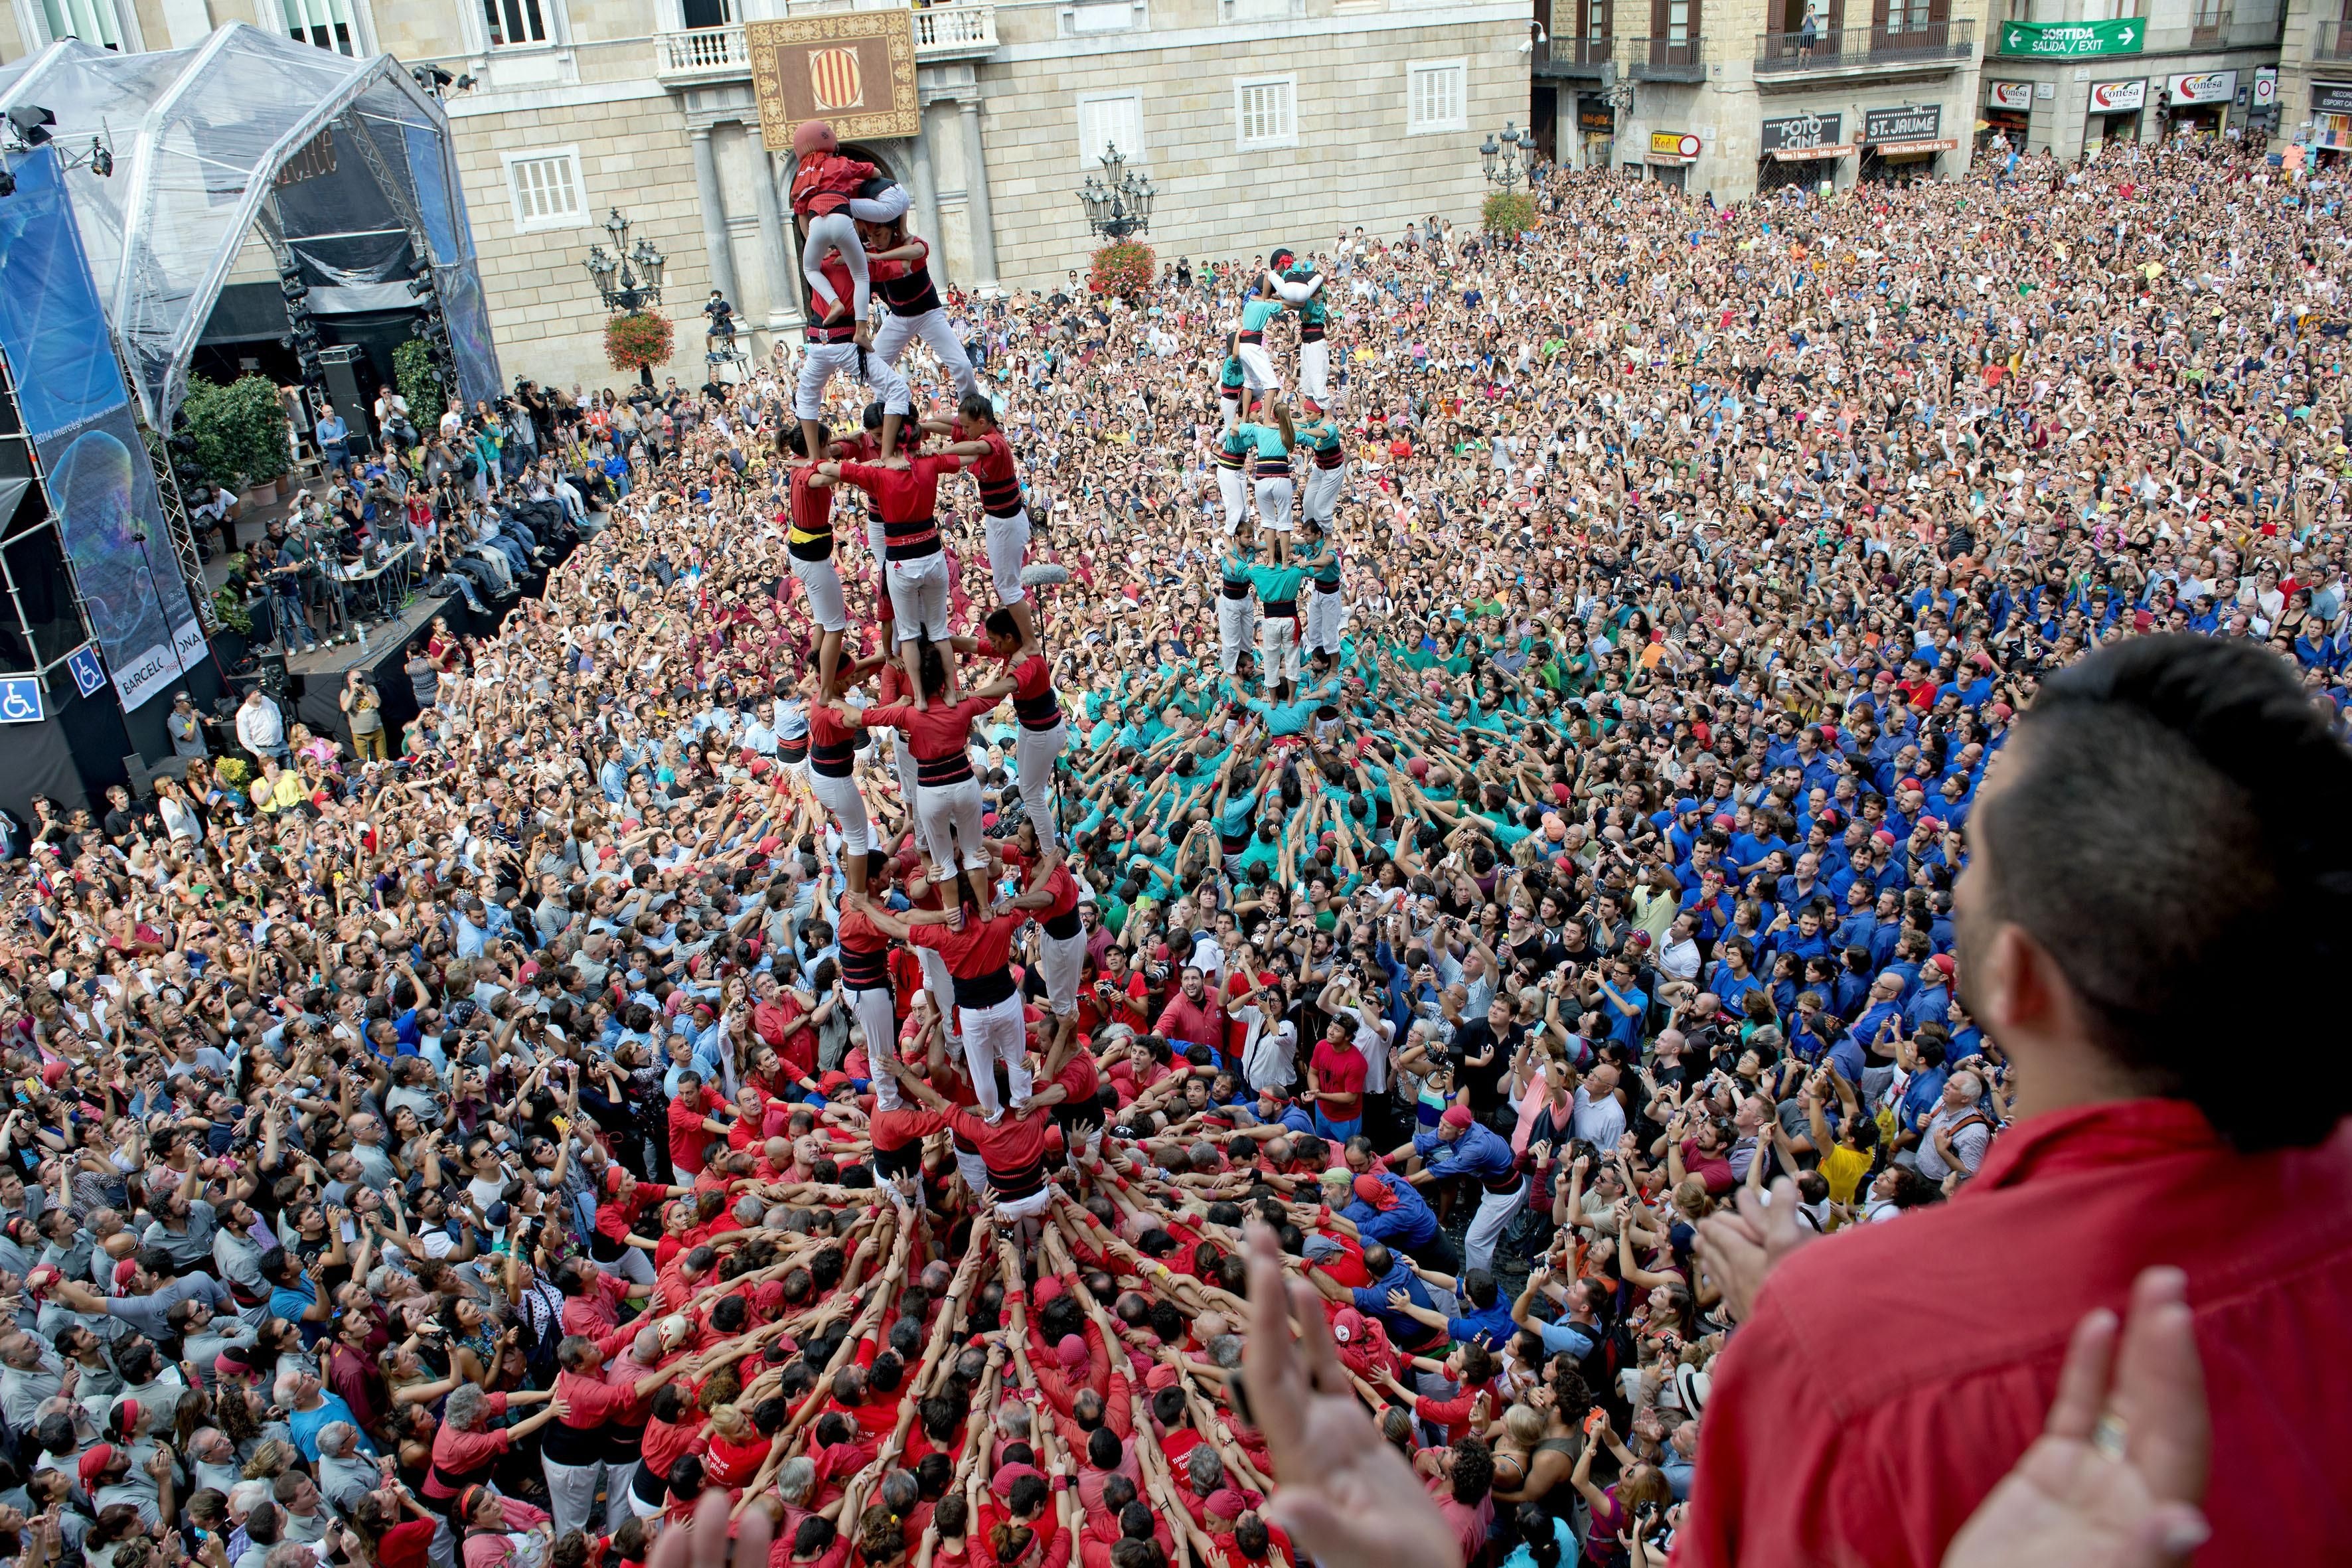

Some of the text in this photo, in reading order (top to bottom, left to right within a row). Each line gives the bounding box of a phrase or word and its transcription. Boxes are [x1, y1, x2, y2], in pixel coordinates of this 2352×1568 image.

[2041, 27, 2094, 40] SORTIDA
[2032, 39, 2104, 54] SALIDA / EXIT
[2189, 79, 2223, 90] conesa
[2002, 88, 2027, 97] conesa
[2103, 88, 2139, 99] conesa
[1781, 118, 1822, 137] FOTO
[1869, 116, 1935, 136] ST. JAUME
[1654, 137, 1679, 150] Kod
[1832, 146, 1852, 155] carnet
[35, 430, 52, 445] 2014
[177, 586, 184, 595] 24
[166, 596, 187, 614] setembre
[165, 654, 187, 674] inspia
[1172, 1449, 1192, 1464] nascu
[710, 1462, 725, 1476] pinya
